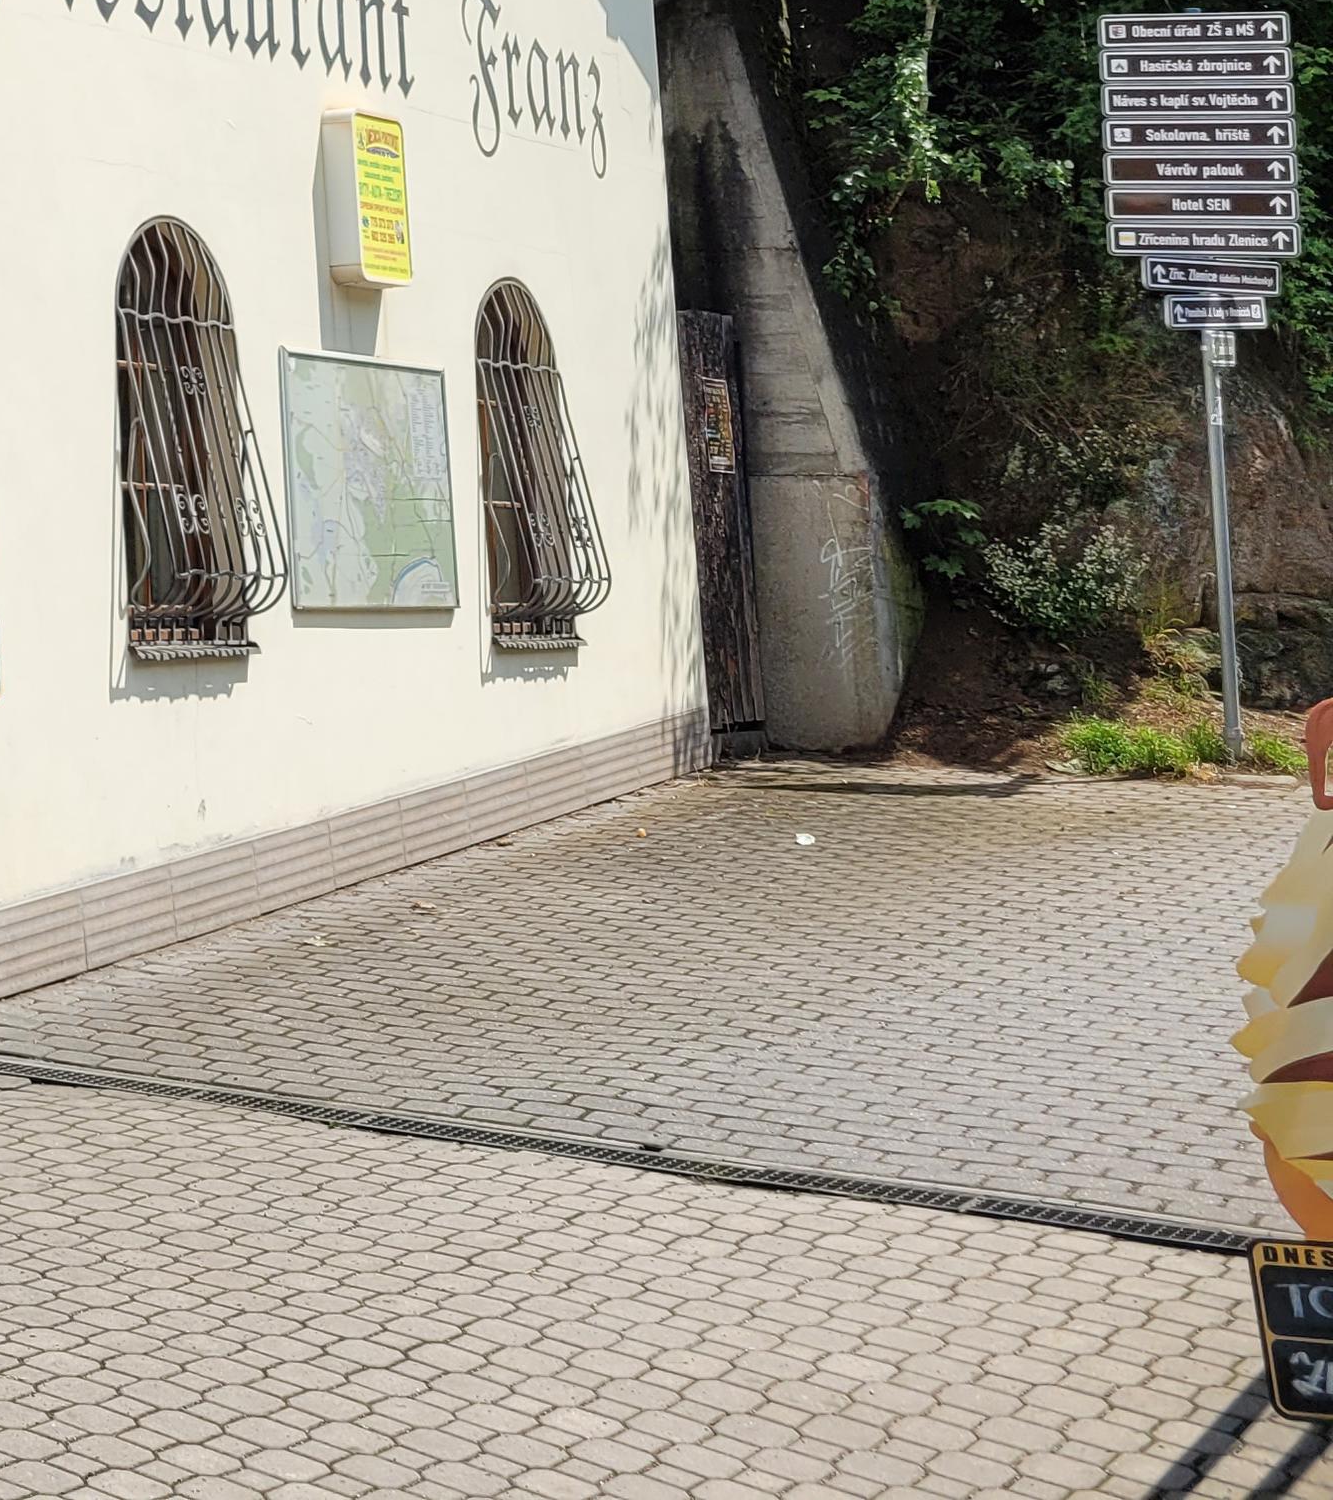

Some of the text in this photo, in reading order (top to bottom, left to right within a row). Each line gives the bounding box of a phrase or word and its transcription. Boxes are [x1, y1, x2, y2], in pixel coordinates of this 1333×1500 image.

[1131, 21, 1255, 38] Obecní úřad ZŠ a MŠ
[1197, 59, 1253, 74] zbrojnice
[1112, 94, 1147, 107] Náves
[1149, 97, 1158, 106] s
[1160, 94, 1190, 109] kaplí
[1215, 128, 1251, 142] hřiště
[1156, 163, 1244, 179] Vávrův palouk
[1172, 198, 1231, 211] Hotel SEN
[1138, 232, 1269, 247] Zřícenina hradu Zlenice
